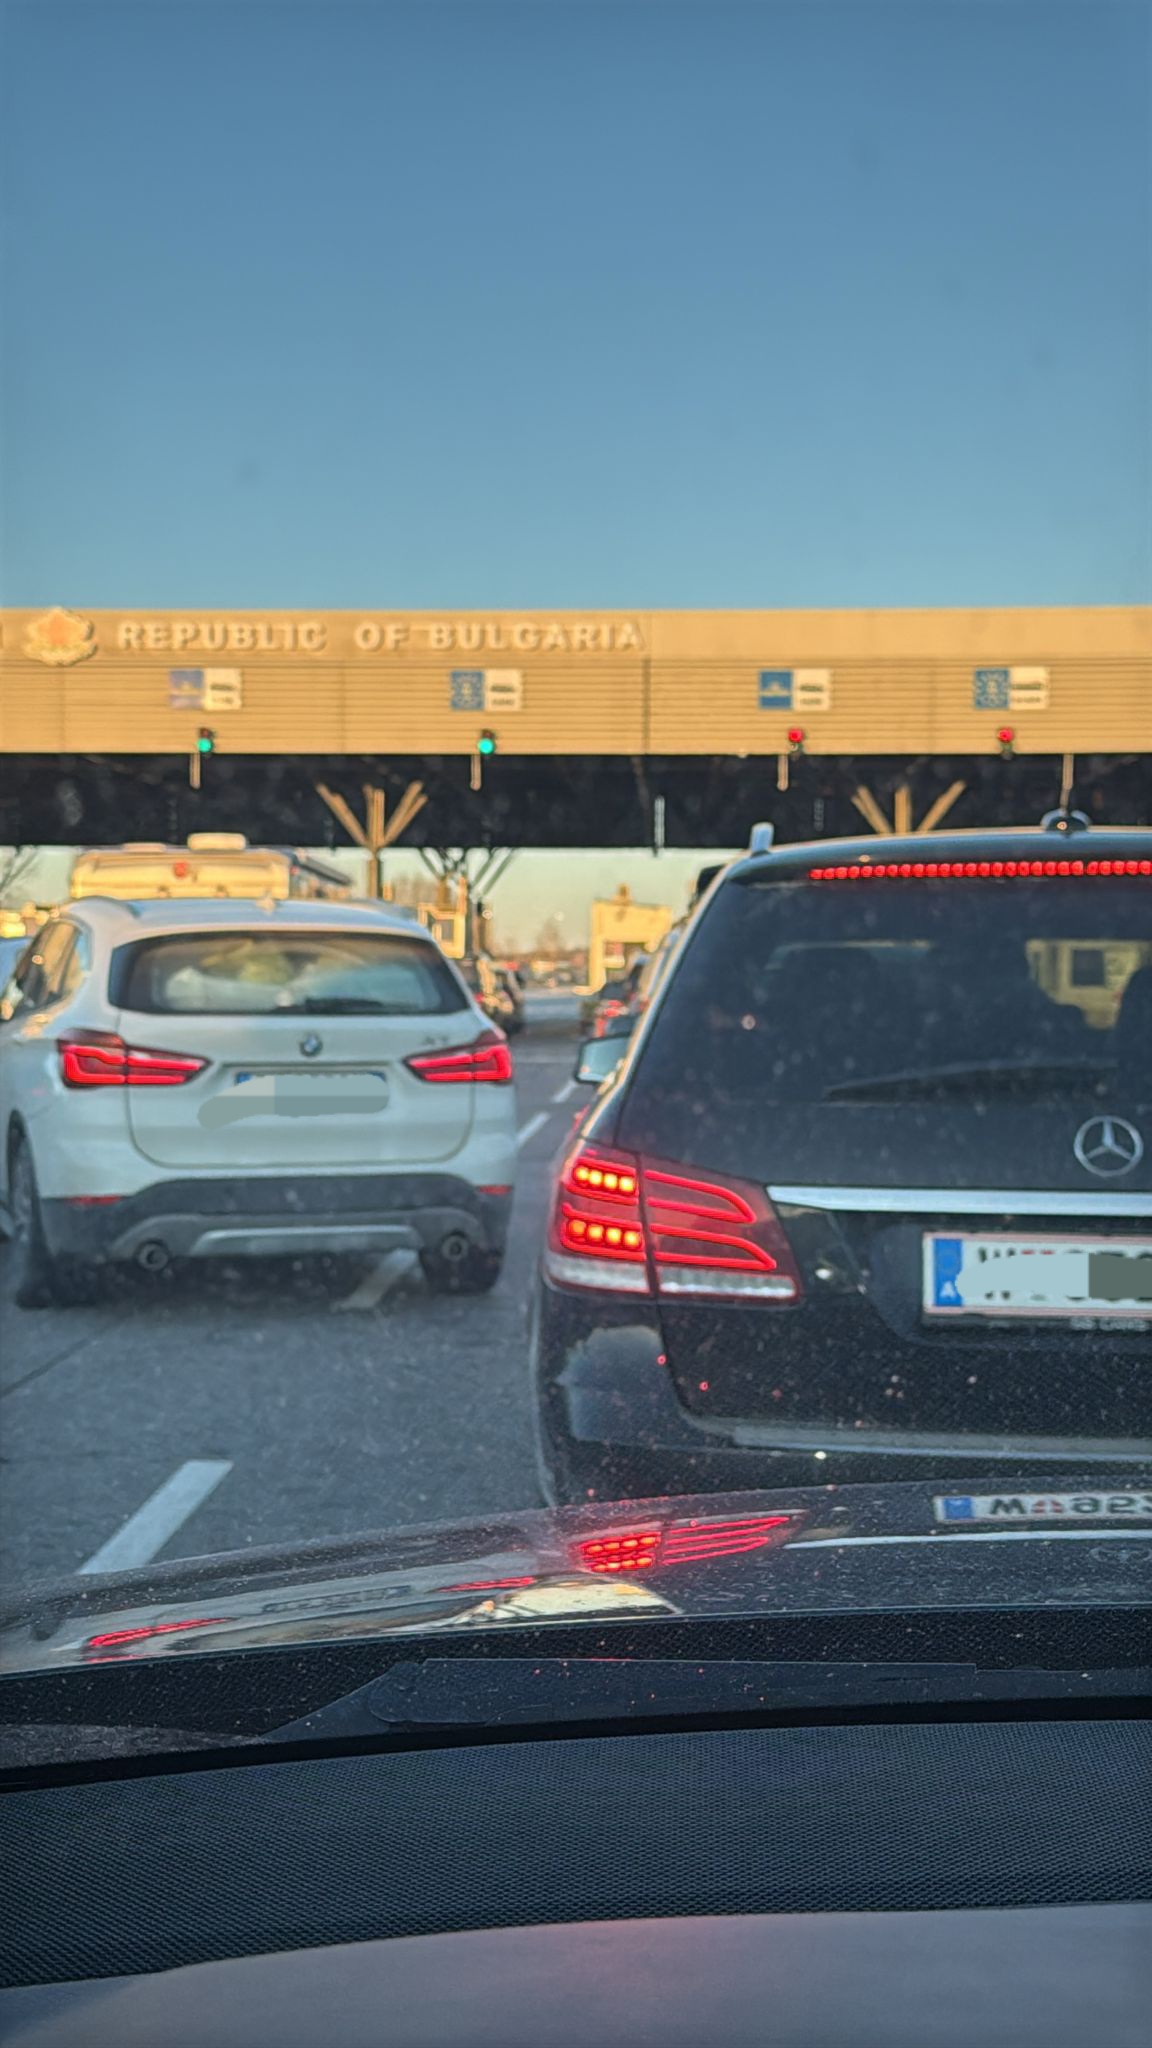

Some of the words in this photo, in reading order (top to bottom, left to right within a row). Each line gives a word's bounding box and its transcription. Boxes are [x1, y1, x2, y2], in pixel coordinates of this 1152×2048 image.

[117, 621, 327, 651] REPUBLIC
[354, 621, 409, 651] OF
[428, 621, 646, 651] BULGARIA
